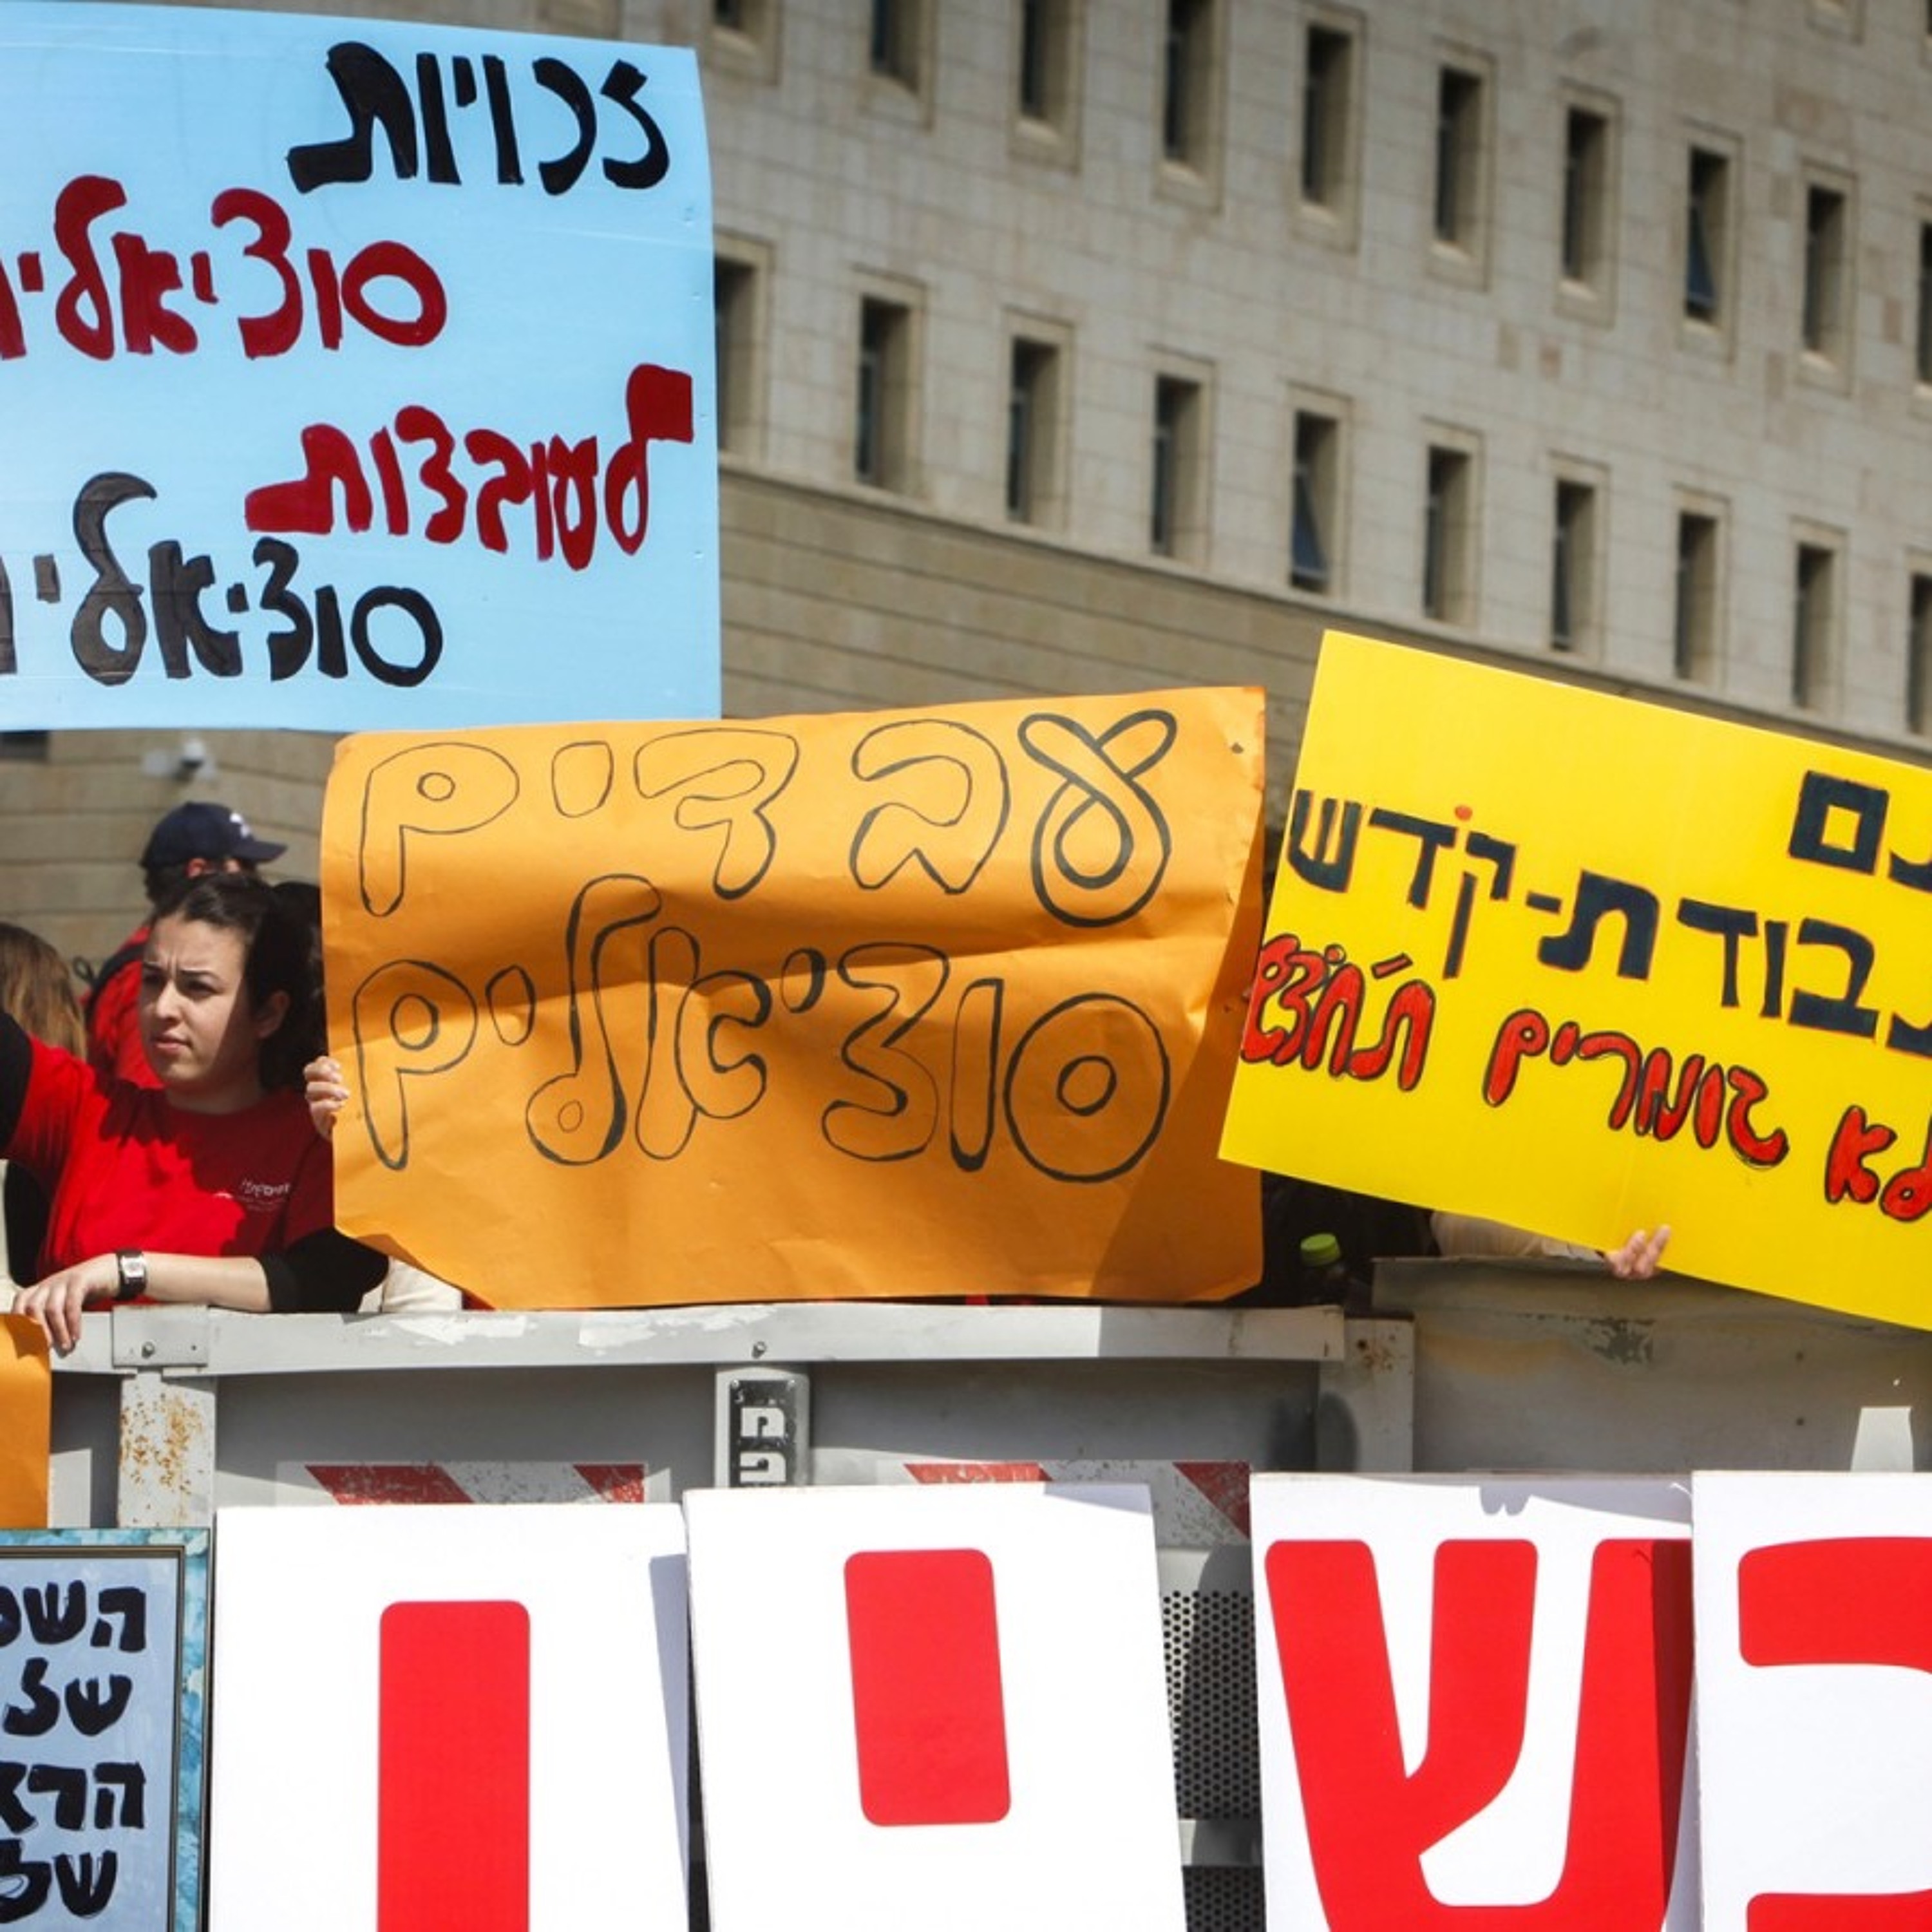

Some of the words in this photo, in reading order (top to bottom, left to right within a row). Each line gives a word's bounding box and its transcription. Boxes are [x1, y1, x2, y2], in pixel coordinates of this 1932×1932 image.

[287, 41, 670, 195] זכויות
[244, 363, 694, 571] לעובדות
[352, 874, 1171, 1184] סוציאלים
